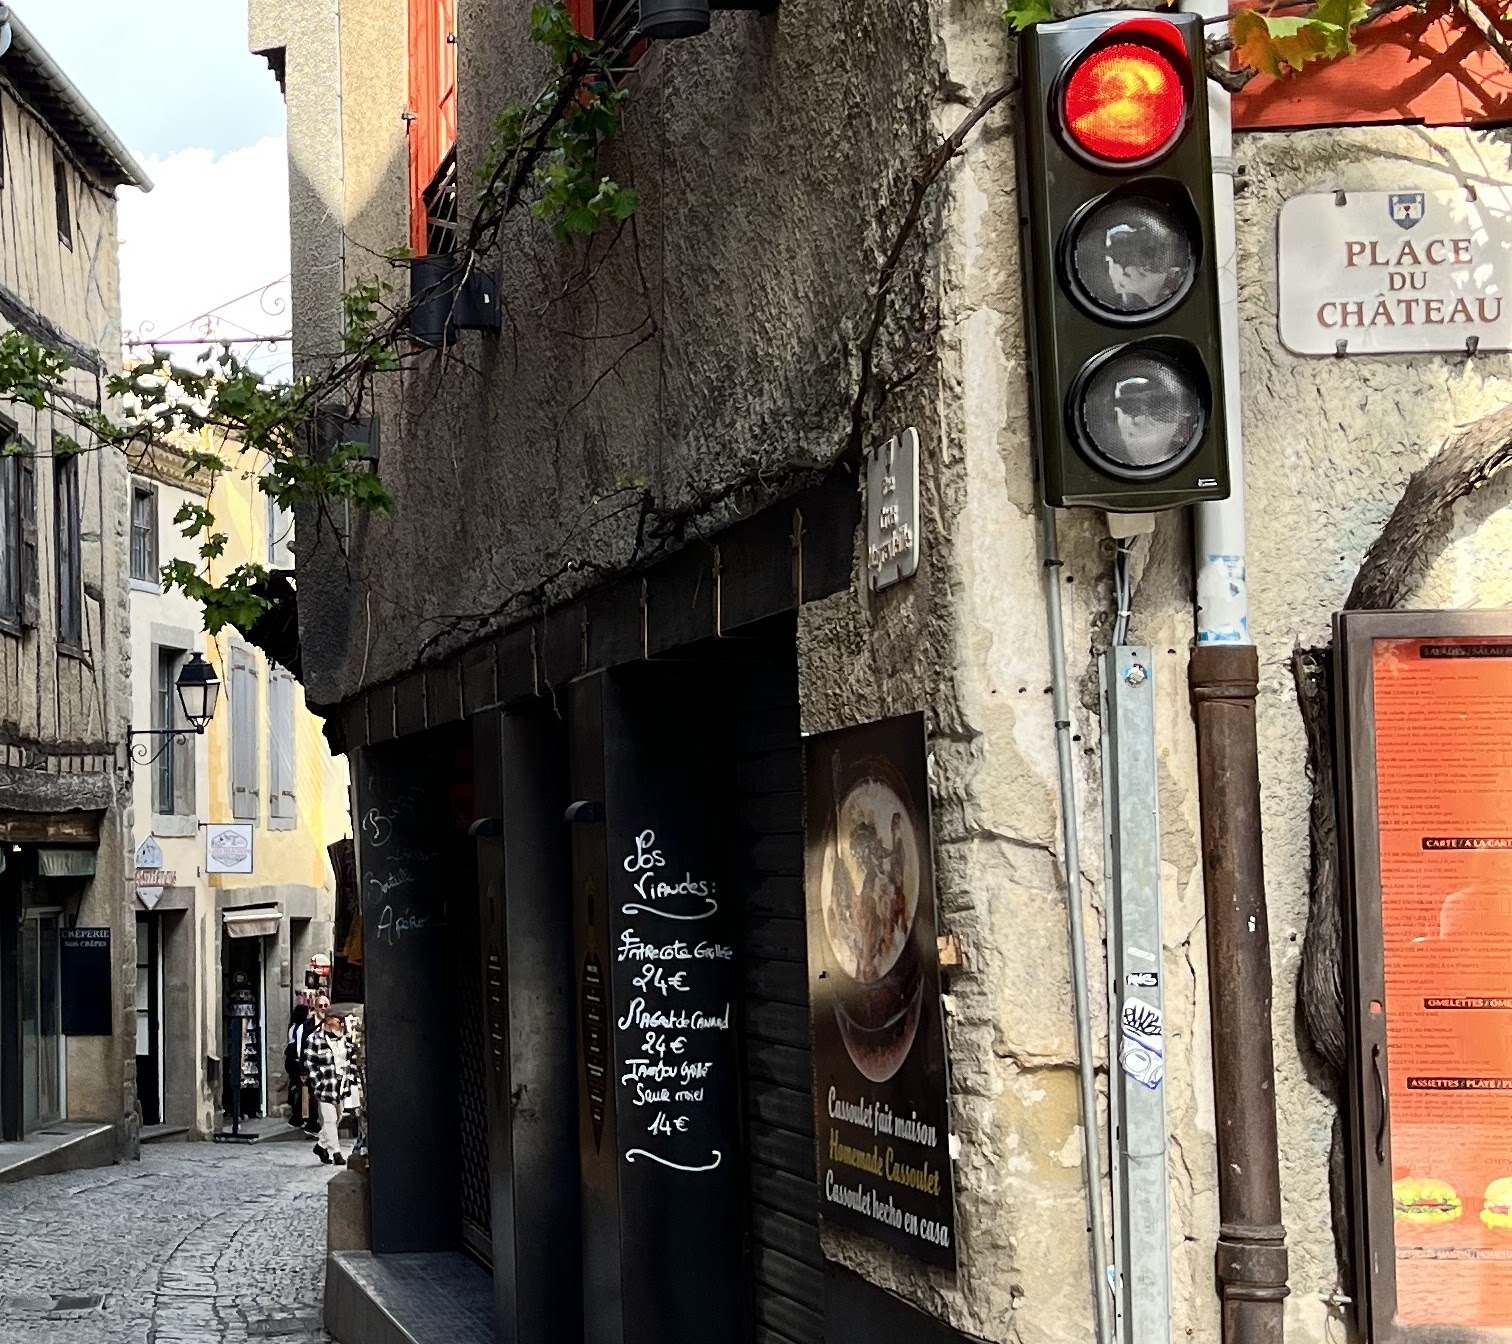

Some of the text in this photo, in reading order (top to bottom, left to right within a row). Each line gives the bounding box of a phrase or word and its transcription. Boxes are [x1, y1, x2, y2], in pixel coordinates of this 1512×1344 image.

[1345, 238, 1473, 269] PLACE
[1388, 271, 1428, 292] DU
[1316, 293, 1504, 328] CHÂTEAU
[1428, 999, 1483, 1008] OMELETTES
[828, 1085, 937, 1147] Cassoulet fait maison
[829, 1127, 941, 1196] Homemade Cassoulet
[826, 1169, 950, 1248] Cassoulet hecho en casa
